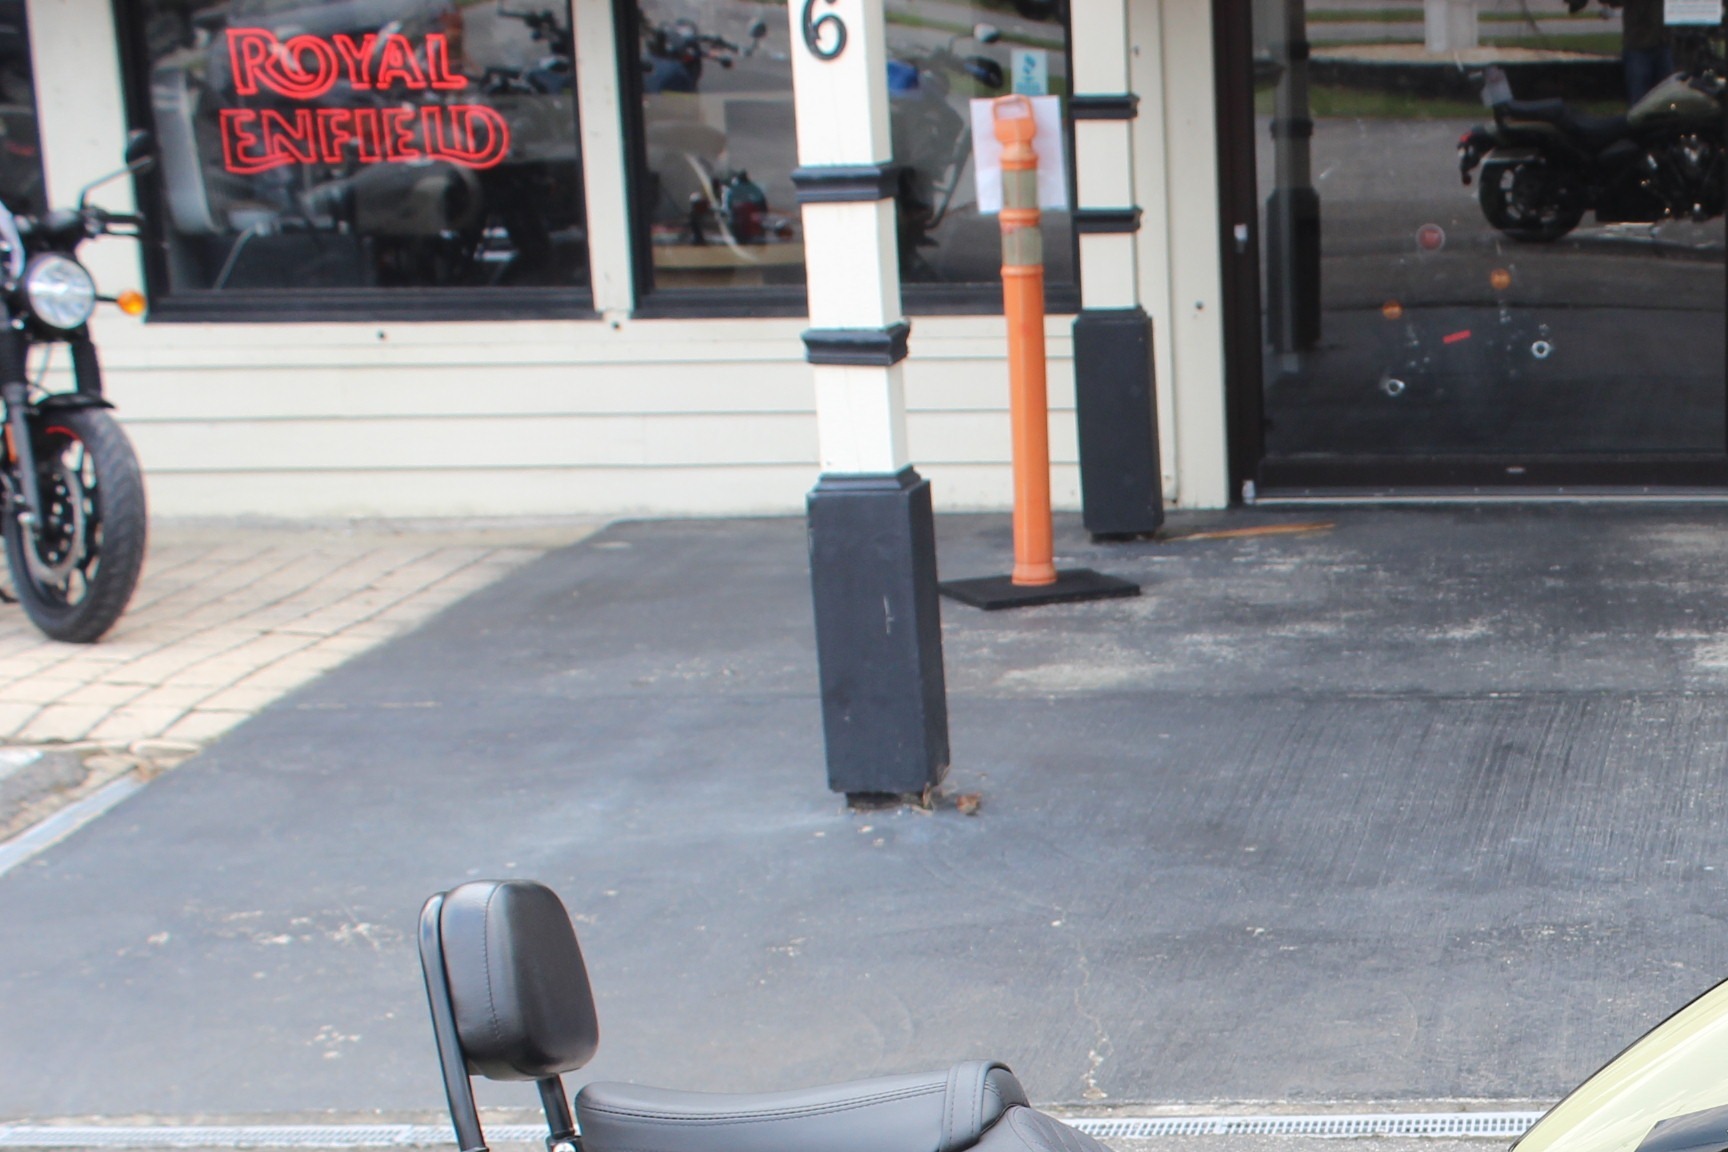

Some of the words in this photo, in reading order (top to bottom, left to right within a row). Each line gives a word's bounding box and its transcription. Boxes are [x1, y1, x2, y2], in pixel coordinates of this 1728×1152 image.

[225, 27, 468, 100] ROYAL
[803, 0, 847, 61] 6
[219, 104, 511, 174] ENFIELD
